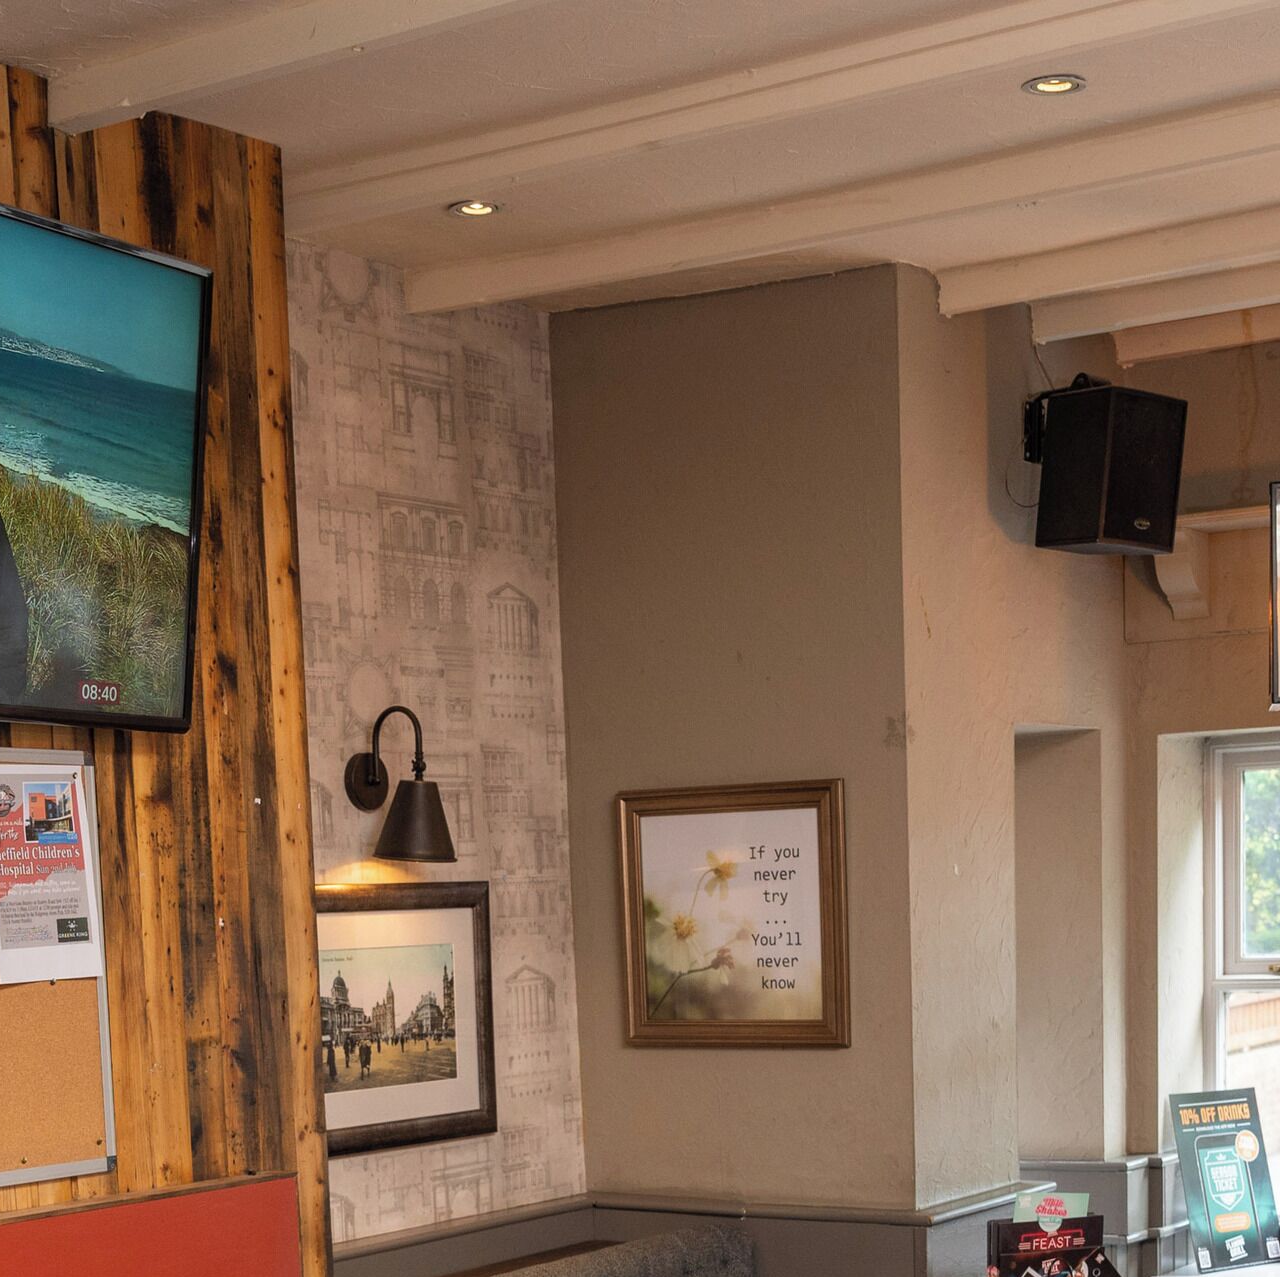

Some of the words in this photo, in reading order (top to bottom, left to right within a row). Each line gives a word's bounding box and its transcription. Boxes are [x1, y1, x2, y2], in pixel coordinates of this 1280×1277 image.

[81, 683, 118, 702] 08:40
[32, 844, 80, 859] Children's
[749, 845, 766, 860] If
[774, 846, 800, 862] you
[754, 869, 797, 881] never
[763, 890, 789, 905] try
[756, 956, 799, 968] never
[761, 976, 796, 990] know
[1179, 1108, 1200, 1125] 10%
[1200, 1106, 1217, 1124] OFF
[1217, 1103, 1251, 1122] DRINKS
[1033, 1235, 1071, 1250] FEAST
